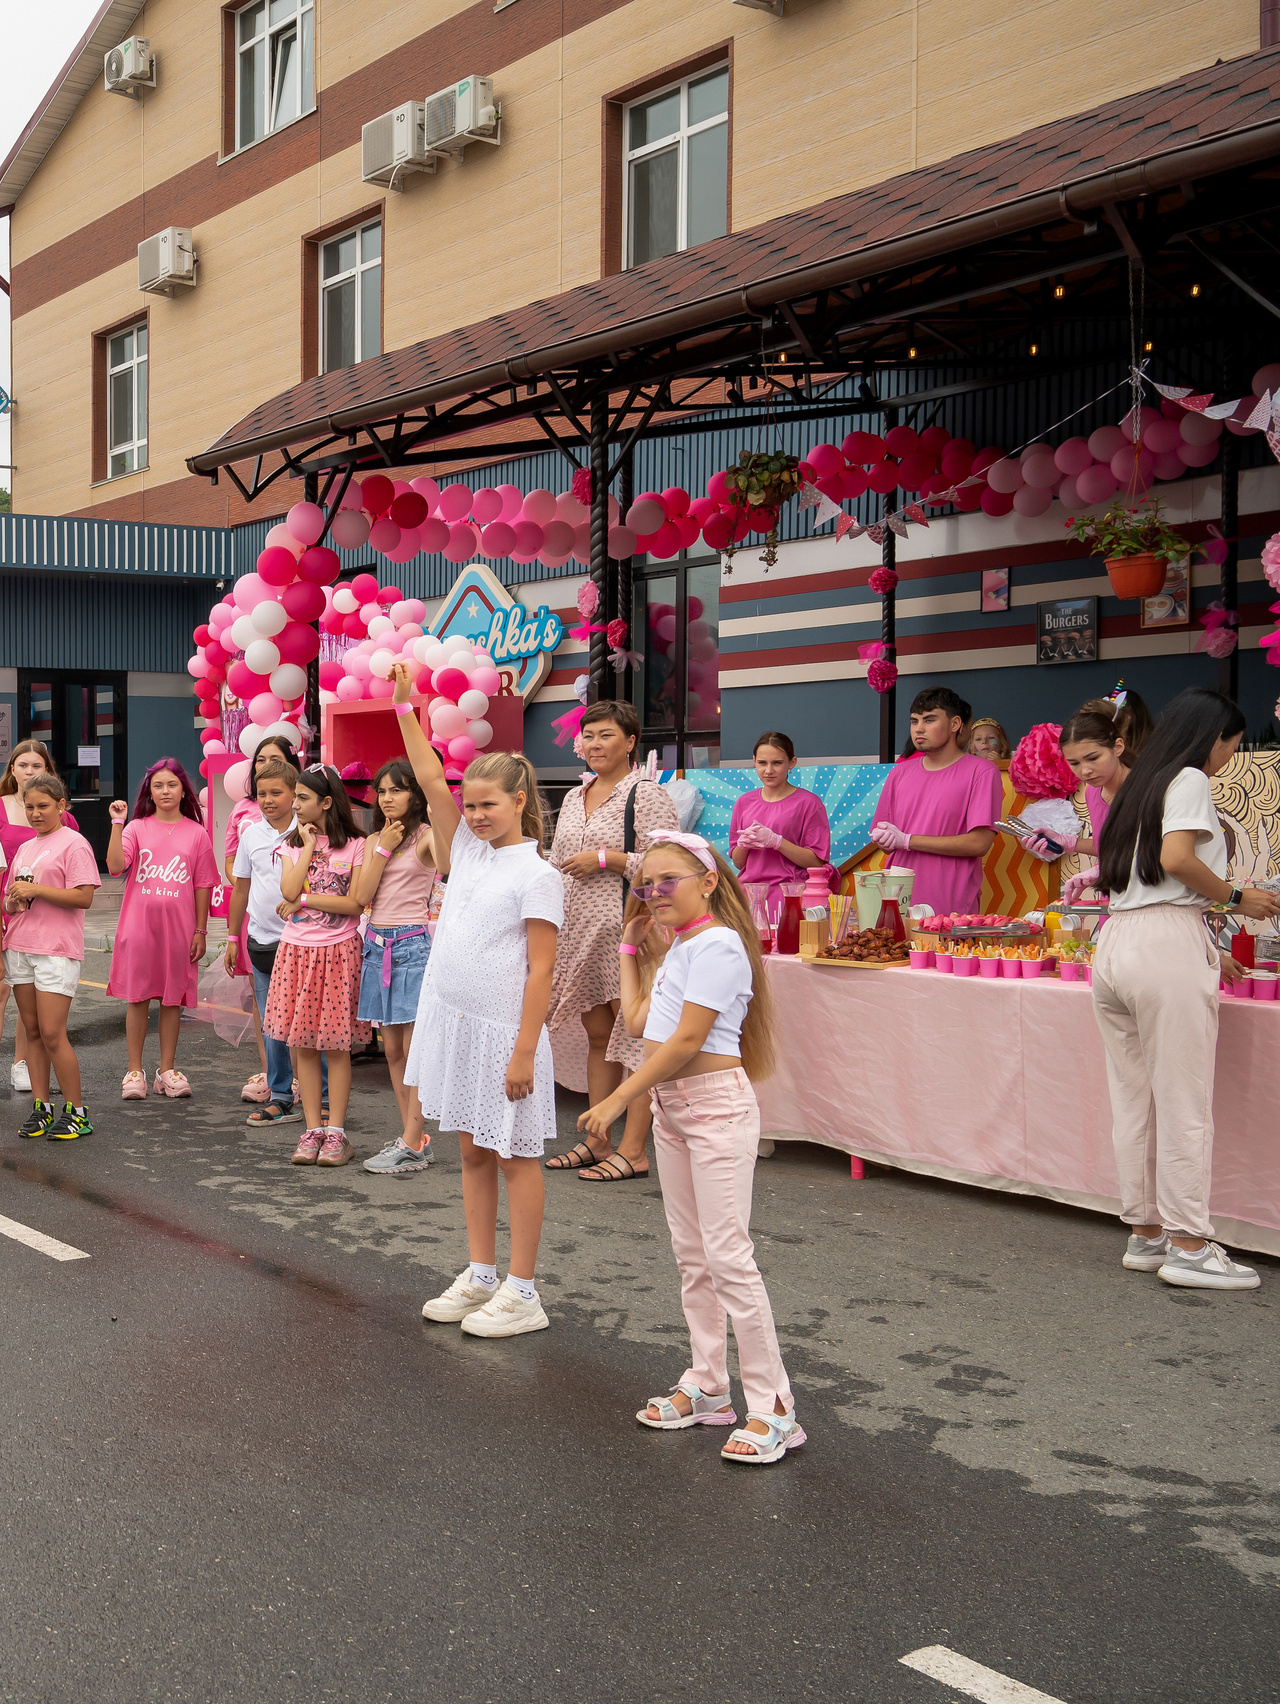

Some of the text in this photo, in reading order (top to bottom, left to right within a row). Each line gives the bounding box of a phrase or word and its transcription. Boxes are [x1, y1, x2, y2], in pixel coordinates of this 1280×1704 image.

[1045, 613, 1089, 630] BURGERS
[135, 848, 190, 884] Barbie
[141, 885, 179, 898] be kind
